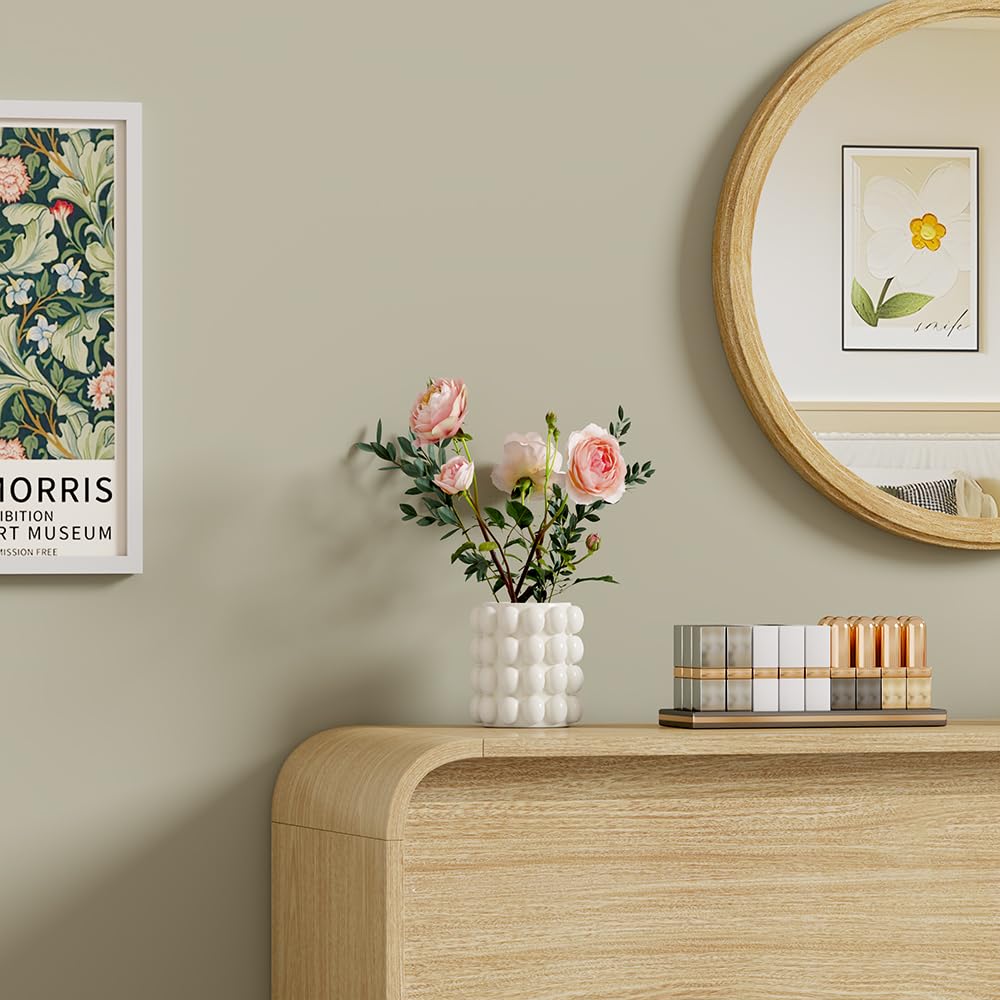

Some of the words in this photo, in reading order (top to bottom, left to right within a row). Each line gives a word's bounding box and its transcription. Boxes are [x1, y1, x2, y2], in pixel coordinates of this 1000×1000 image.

[0, 477, 113, 503] ORRIS
[0, 510, 54, 522] IBITION
[28, 526, 112, 541] MUSEUM
[36, 547, 58, 557] FREE
